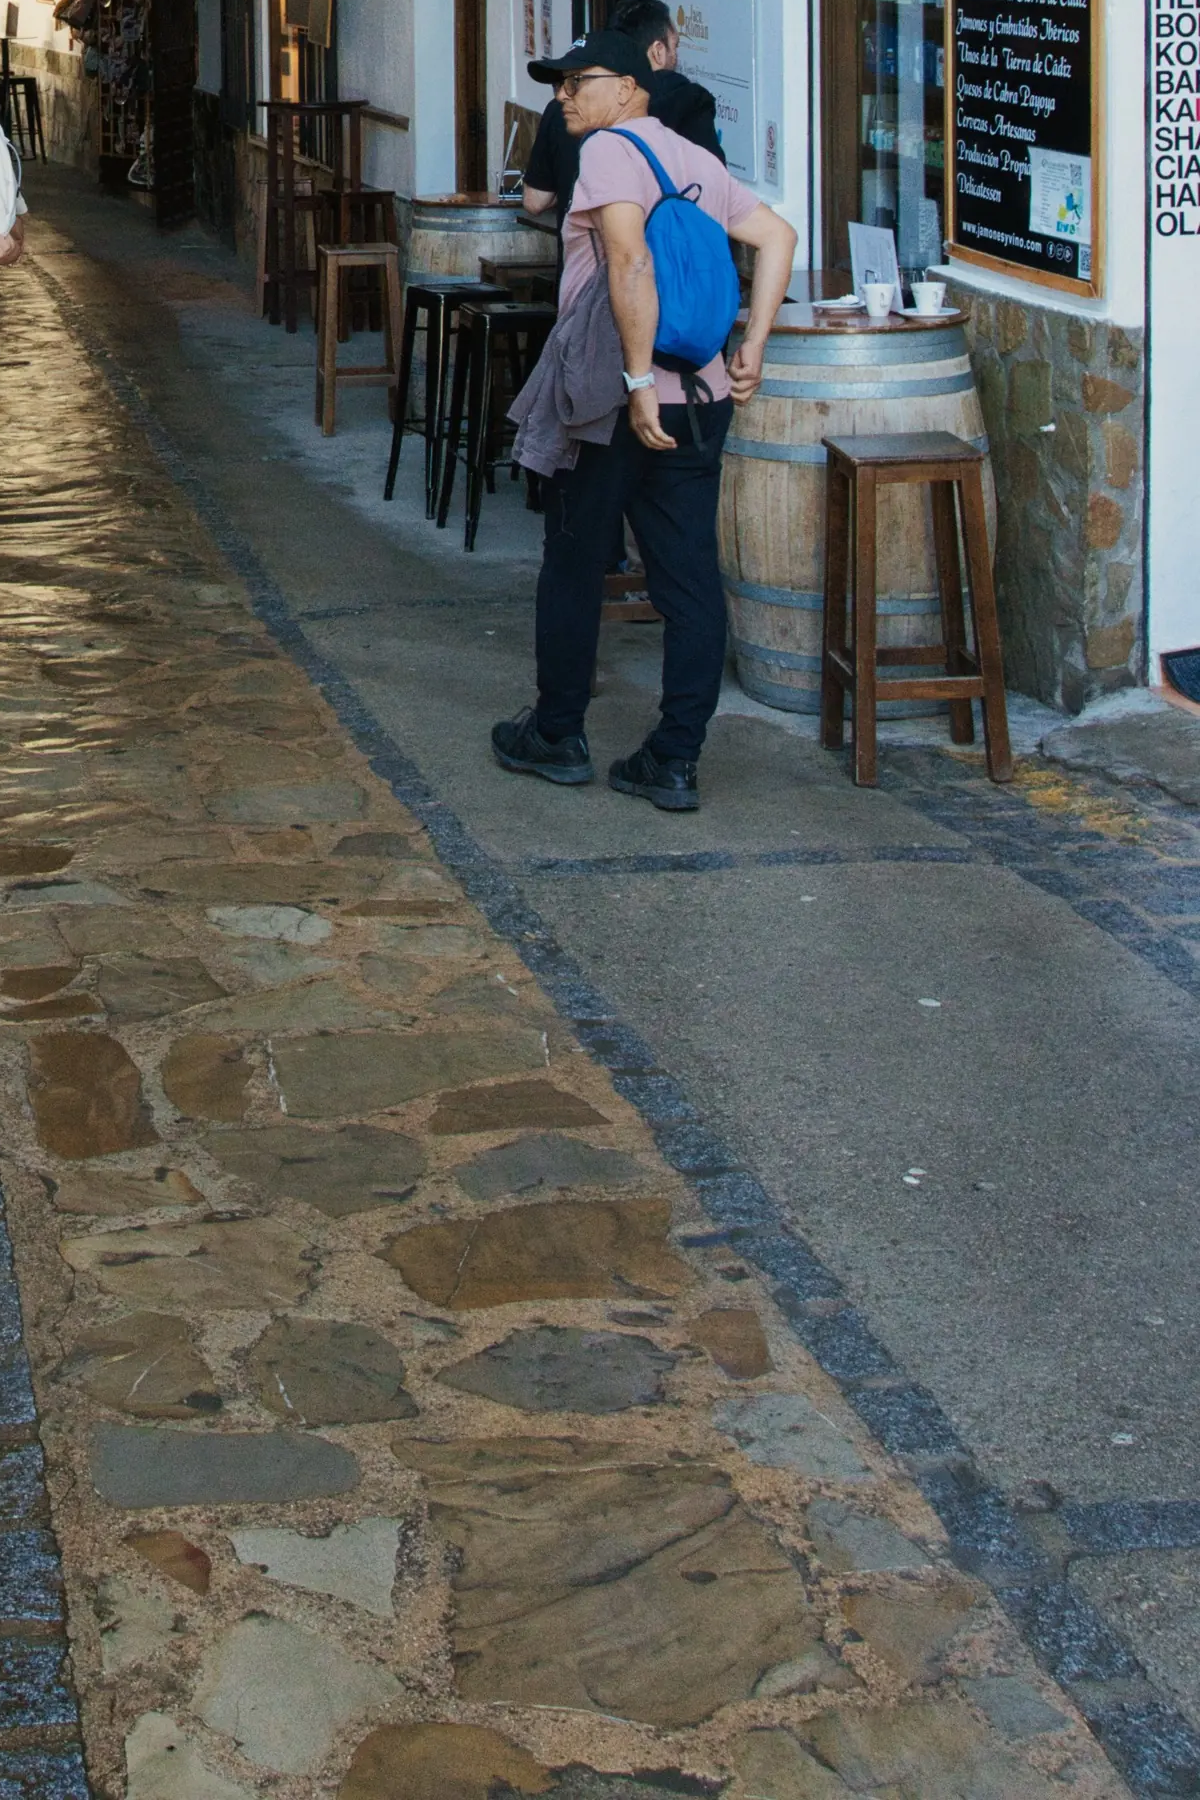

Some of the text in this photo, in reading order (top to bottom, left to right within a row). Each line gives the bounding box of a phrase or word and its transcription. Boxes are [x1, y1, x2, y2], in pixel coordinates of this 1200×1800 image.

[956, 8, 1080, 43] Jamones y Embutidos Ibéricos
[1155, 12, 1200, 38] BO
[958, 41, 1072, 78] Vinos de la Tierra de Cádiz
[1155, 41, 1200, 66] KO
[956, 73, 1056, 118] Quesos de Cabra Payoya
[1155, 70, 1200, 95] BA
[1155, 98, 1200, 123] KA
[956, 107, 1037, 143] Cervezas Artesanas
[1155, 126, 1200, 152] SH
[956, 139, 999, 168] Producción
[956, 172, 1002, 203] Delicatessen
[1155, 182, 1200, 208] HA
[962, 221, 1042, 253] www.jamonesyvino.com
[1155, 211, 1200, 237] OL
